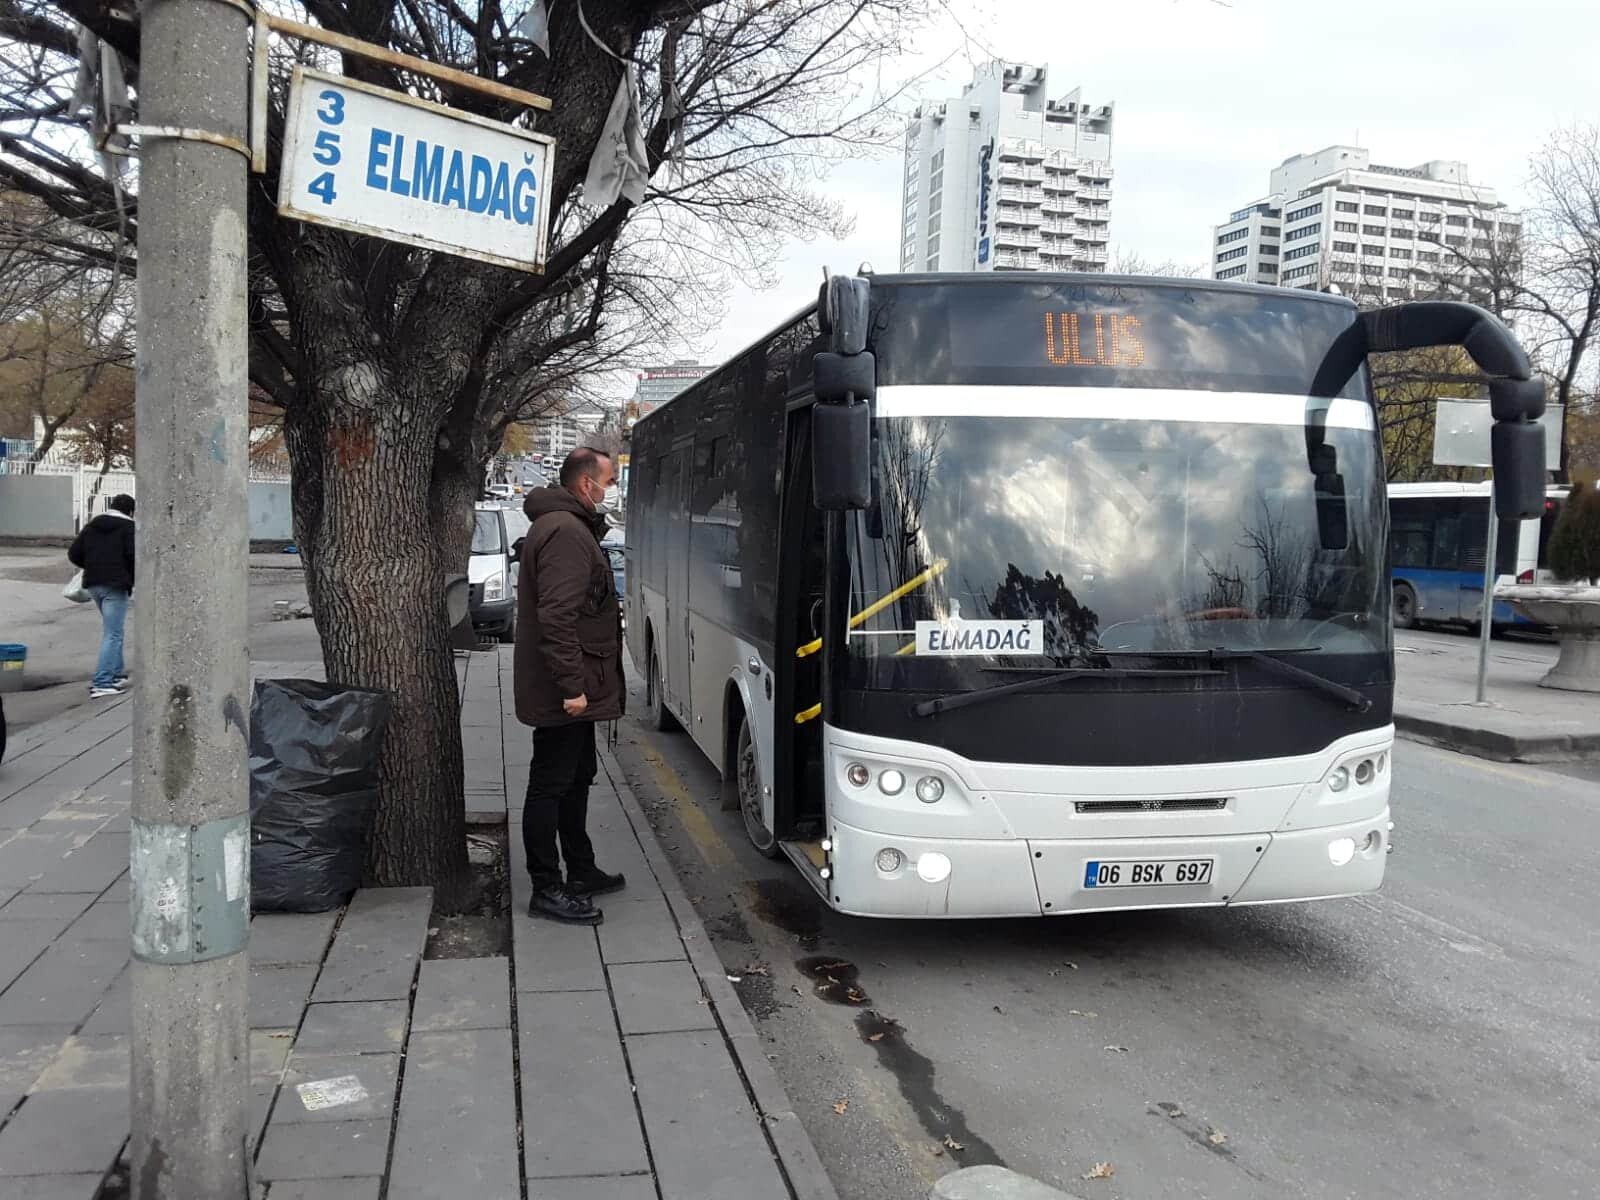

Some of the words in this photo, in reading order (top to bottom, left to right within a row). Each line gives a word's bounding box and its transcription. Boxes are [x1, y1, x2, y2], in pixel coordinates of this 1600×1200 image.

[366, 127, 537, 226] ELMADAĞ
[1045, 312, 1144, 367] ULUS
[928, 624, 1031, 651] ELMADAĞ
[1099, 865, 1120, 884] 06
[1131, 864, 1165, 883] BSK
[1176, 863, 1210, 882] 697
